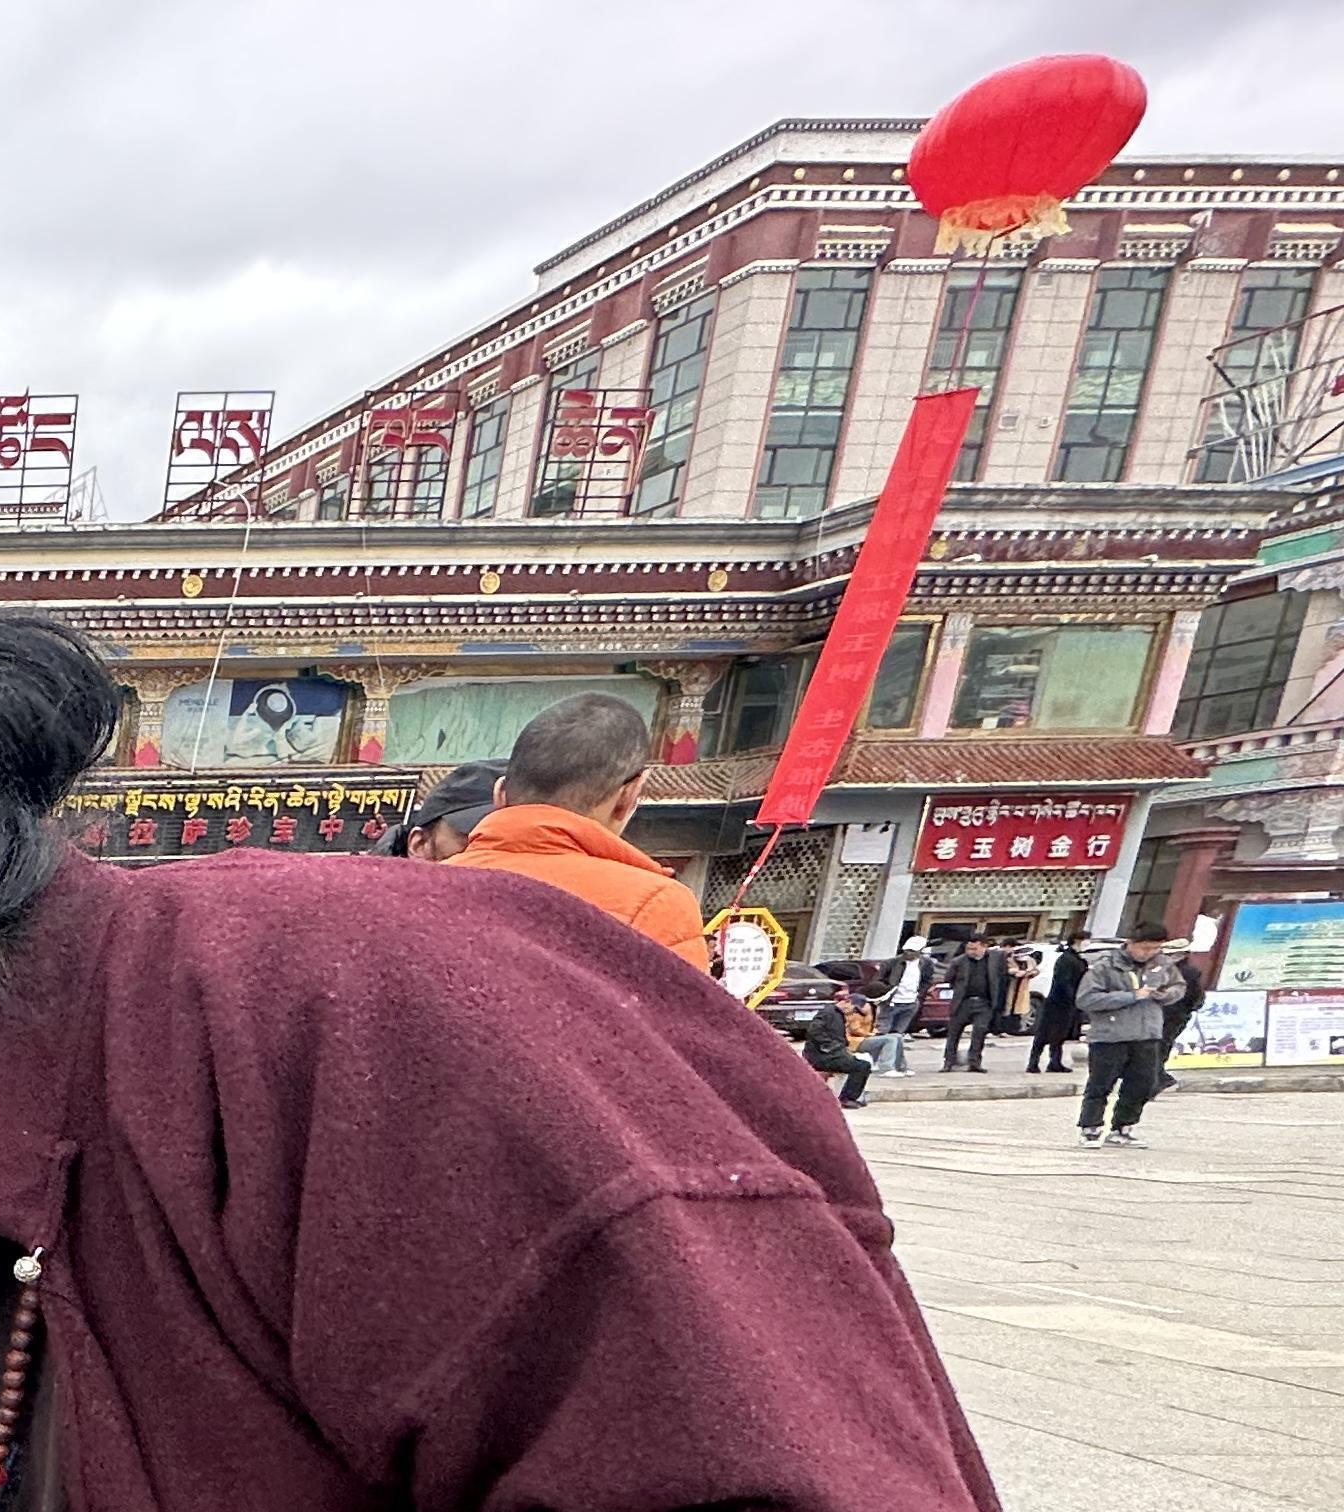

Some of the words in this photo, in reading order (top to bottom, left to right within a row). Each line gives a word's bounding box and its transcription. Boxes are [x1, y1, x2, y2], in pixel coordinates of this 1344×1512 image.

[83, 813, 388, 847] 拉萨珍宝中心
[933, 835, 1111, 860] 老玉树金行
